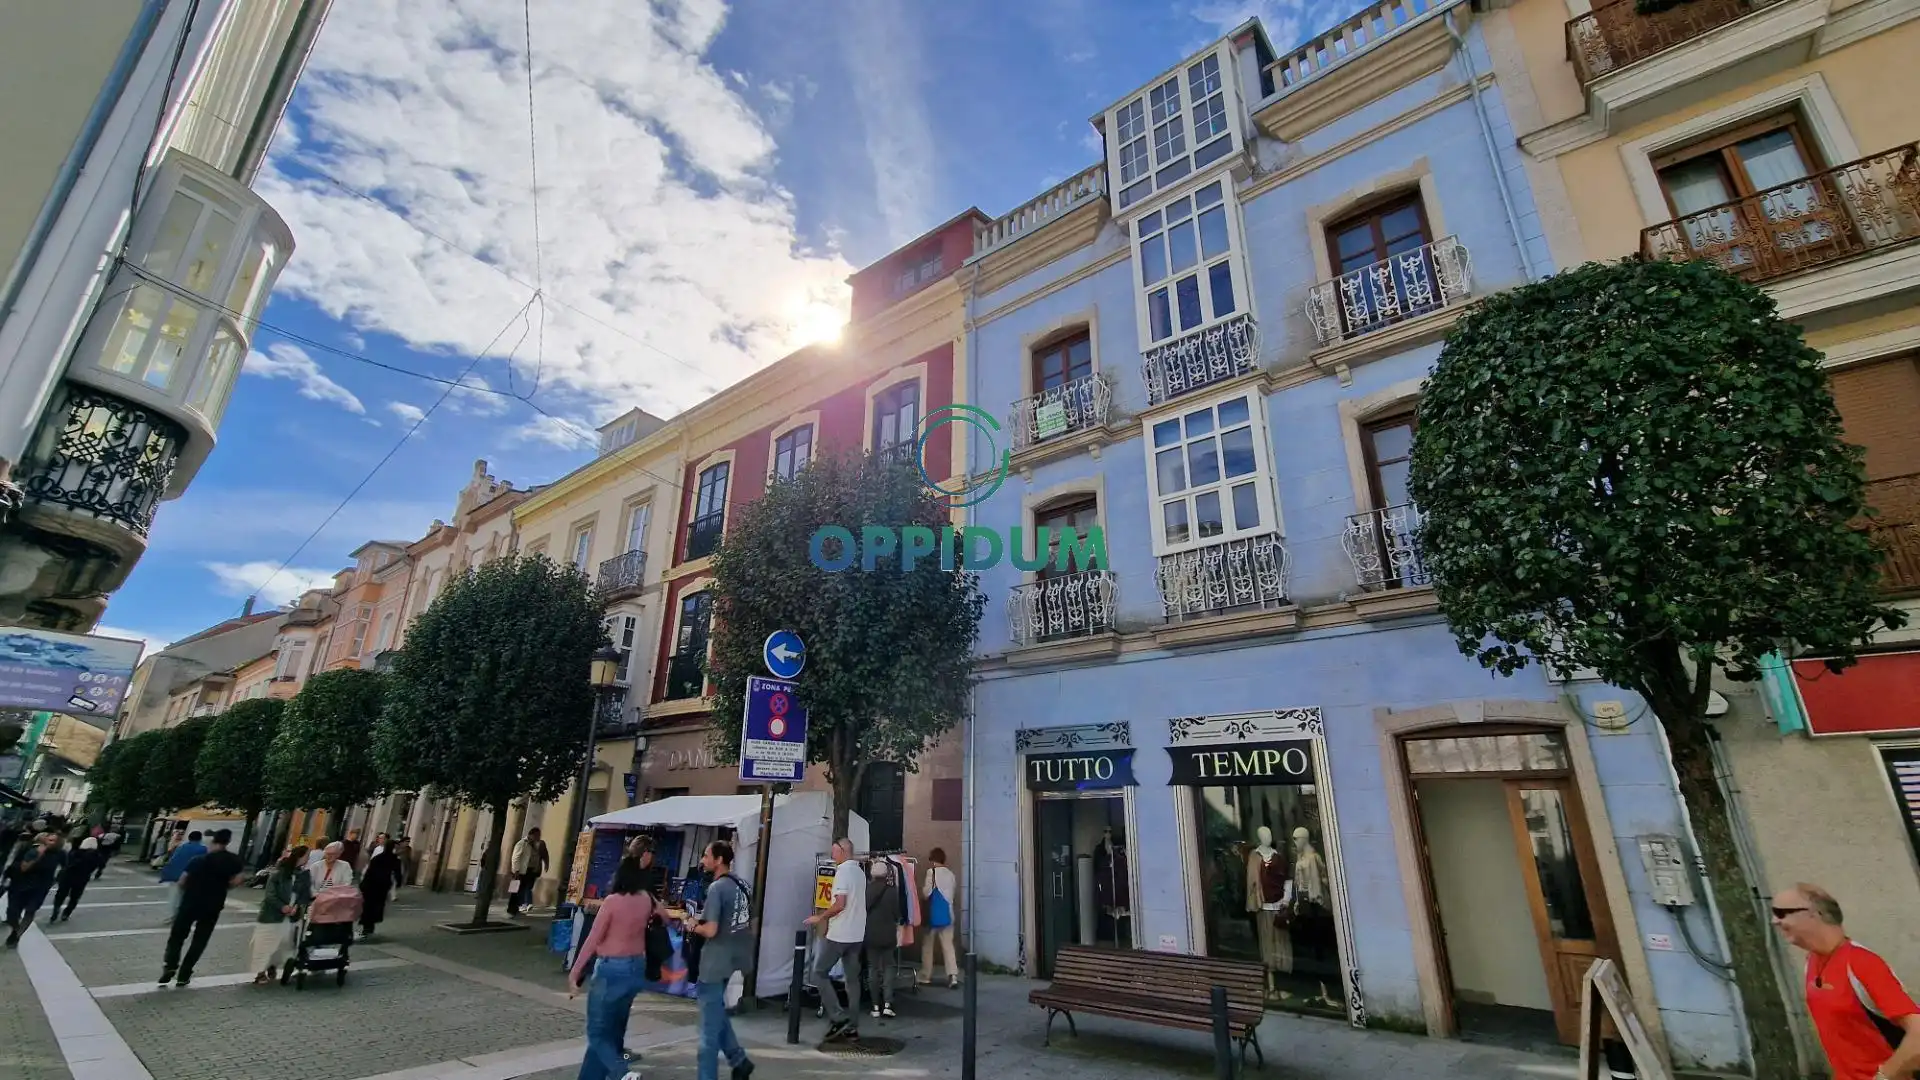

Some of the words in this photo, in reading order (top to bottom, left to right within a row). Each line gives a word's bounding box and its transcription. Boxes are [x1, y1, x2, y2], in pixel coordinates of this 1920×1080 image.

[761, 683, 780, 691] ZONA
[1031, 756, 1114, 782] TUTTO
[1192, 748, 1308, 778] TEMPO
